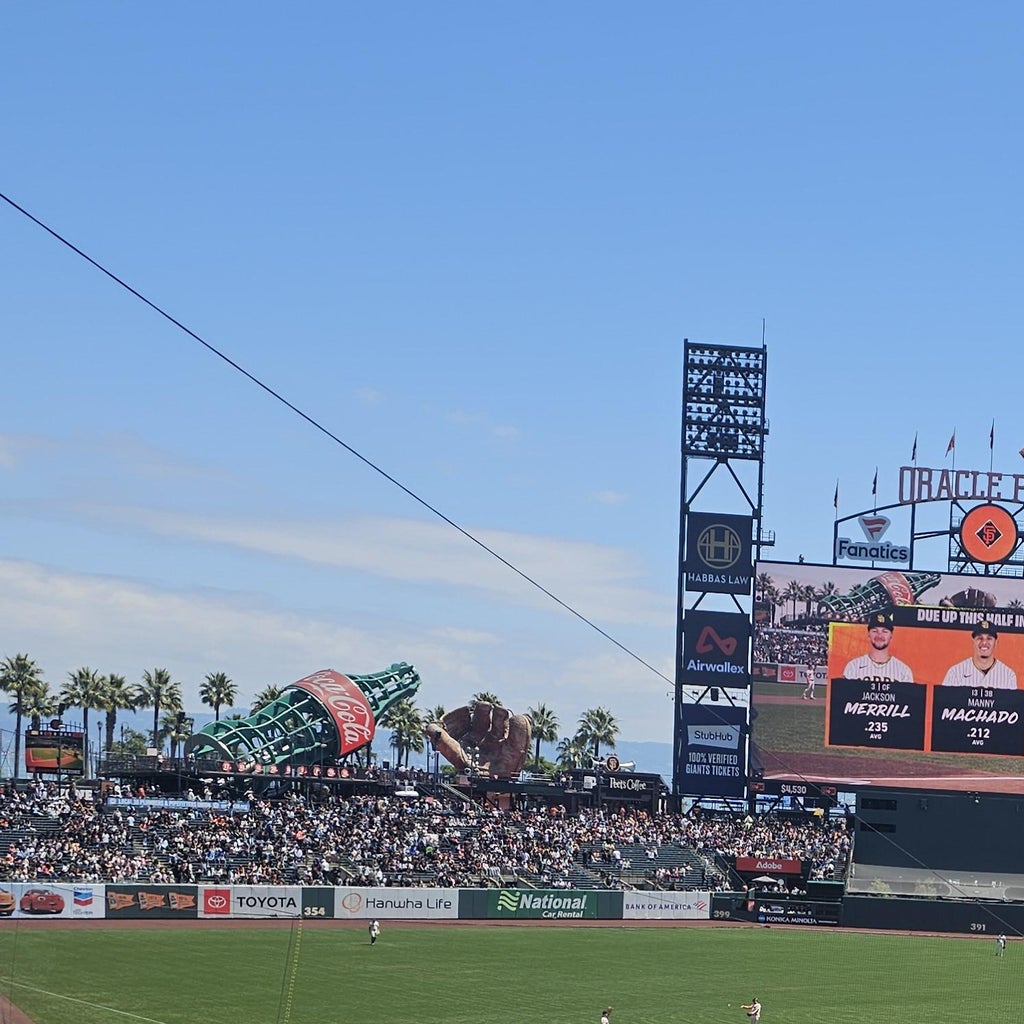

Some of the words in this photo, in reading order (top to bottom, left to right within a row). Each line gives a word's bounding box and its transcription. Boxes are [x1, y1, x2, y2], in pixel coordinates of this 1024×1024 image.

[898, 466, 1002, 504] ORACLE
[838, 539, 908, 561] Fanatics
[687, 571, 726, 584] HABBAS
[728, 574, 748, 585] LAW
[917, 608, 940, 622] DUE
[941, 610, 958, 624] UP
[960, 611, 985, 625] THIS
[986, 612, 1014, 627] HALF
[687, 659, 744, 674] Airwallex
[871, 683, 876, 691] 3
[882, 683, 891, 691] CF
[971, 689, 978, 697] 13
[862, 692, 896, 702] JACKSON
[968, 698, 995, 708] MANNY
[844, 702, 911, 718] MERRILL
[941, 708, 1019, 725] MACHADO
[864, 721, 888, 733] .235
[694, 730, 733, 742] StubHub
[967, 728, 990, 739] .212
[688, 752, 707, 763] 100%
[708, 753, 738, 765] VERIFIED
[685, 763, 711, 776] GIANTS
[712, 765, 740, 777] TICKETS
[626, 778, 647, 791] Coffee
[780, 784, 807, 794] $4,530
[756, 861, 783, 870] Adobe
[236, 896, 297, 909] TOYOTA
[366, 896, 423, 910] Hanwha
[425, 897, 452, 910] Life
[519, 893, 587, 910] National
[625, 903, 647, 911] BANK
[648, 903, 657, 911] OF
[658, 903, 692, 911] AMERICA
[304, 906, 326, 916] 354
[542, 909, 556, 918] Car
[557, 909, 583, 918] Rental
[714, 910, 731, 919] 399
[766, 915, 790, 923] KONICA
[790, 916, 817, 925] MINOLTA
[970, 923, 986, 932] 391
